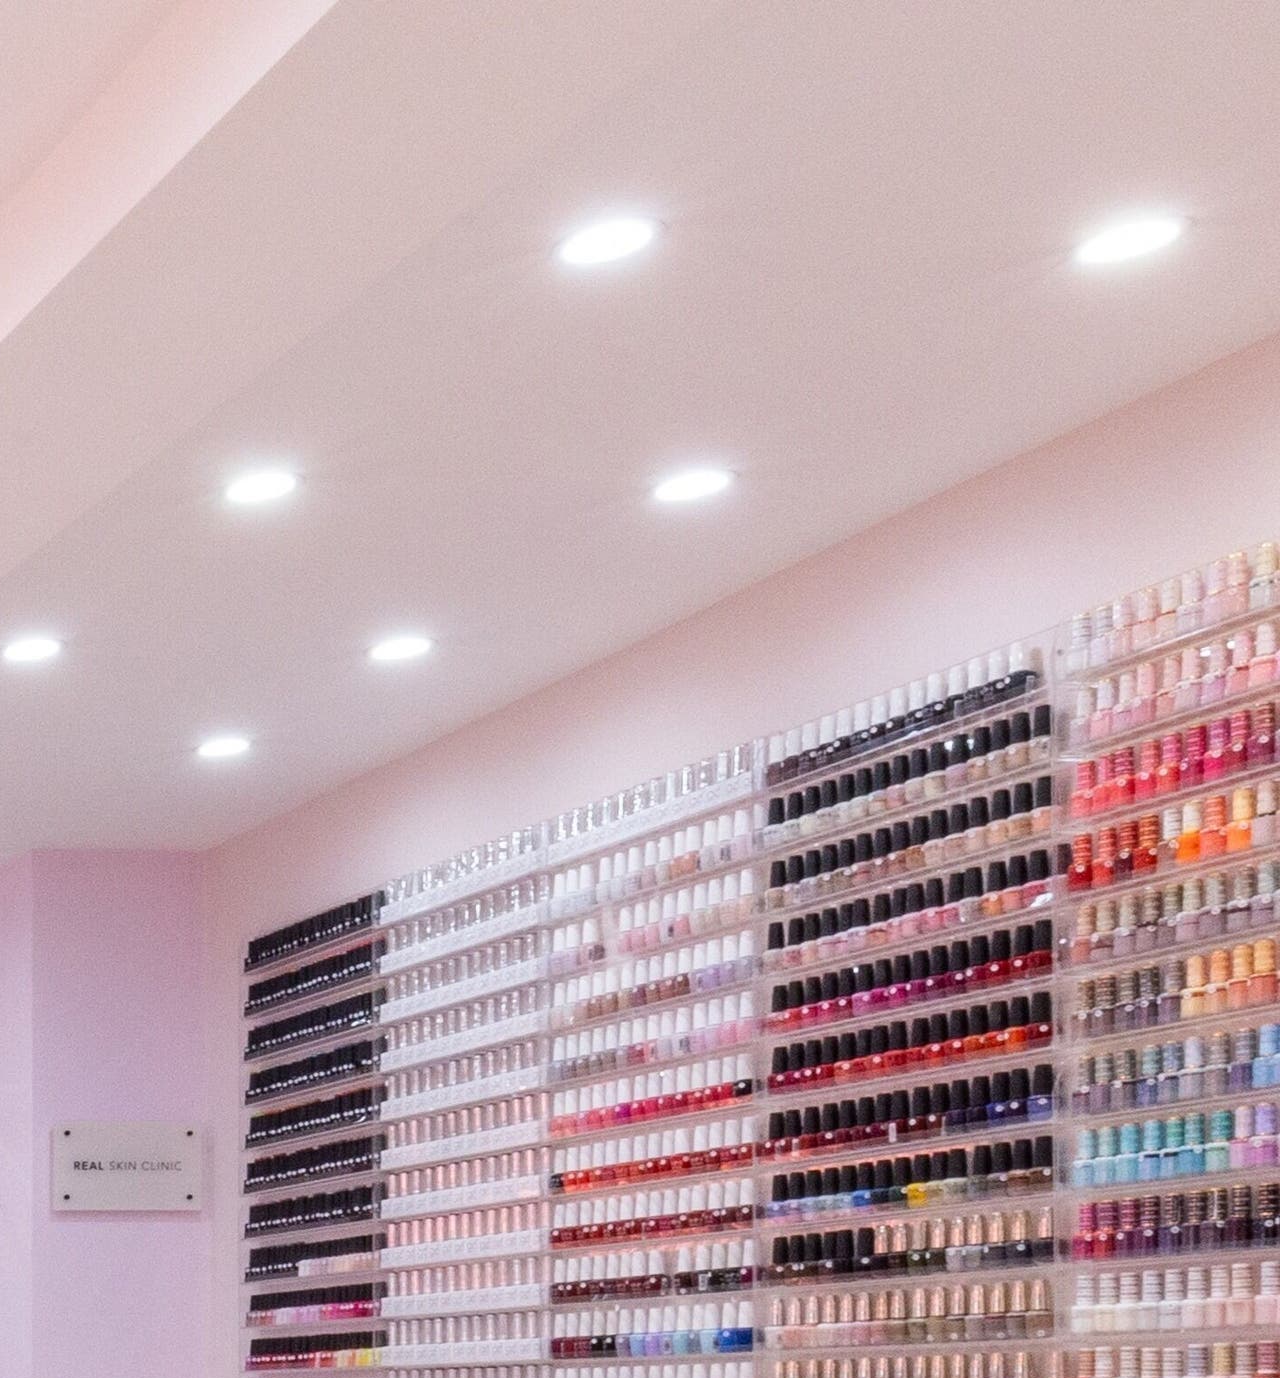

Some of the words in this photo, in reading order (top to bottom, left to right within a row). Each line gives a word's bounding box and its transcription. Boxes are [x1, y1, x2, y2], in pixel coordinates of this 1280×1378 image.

[73, 1160, 105, 1171] REAL
[109, 1160, 138, 1171] SKIN
[141, 1160, 183, 1171] CLINIC
